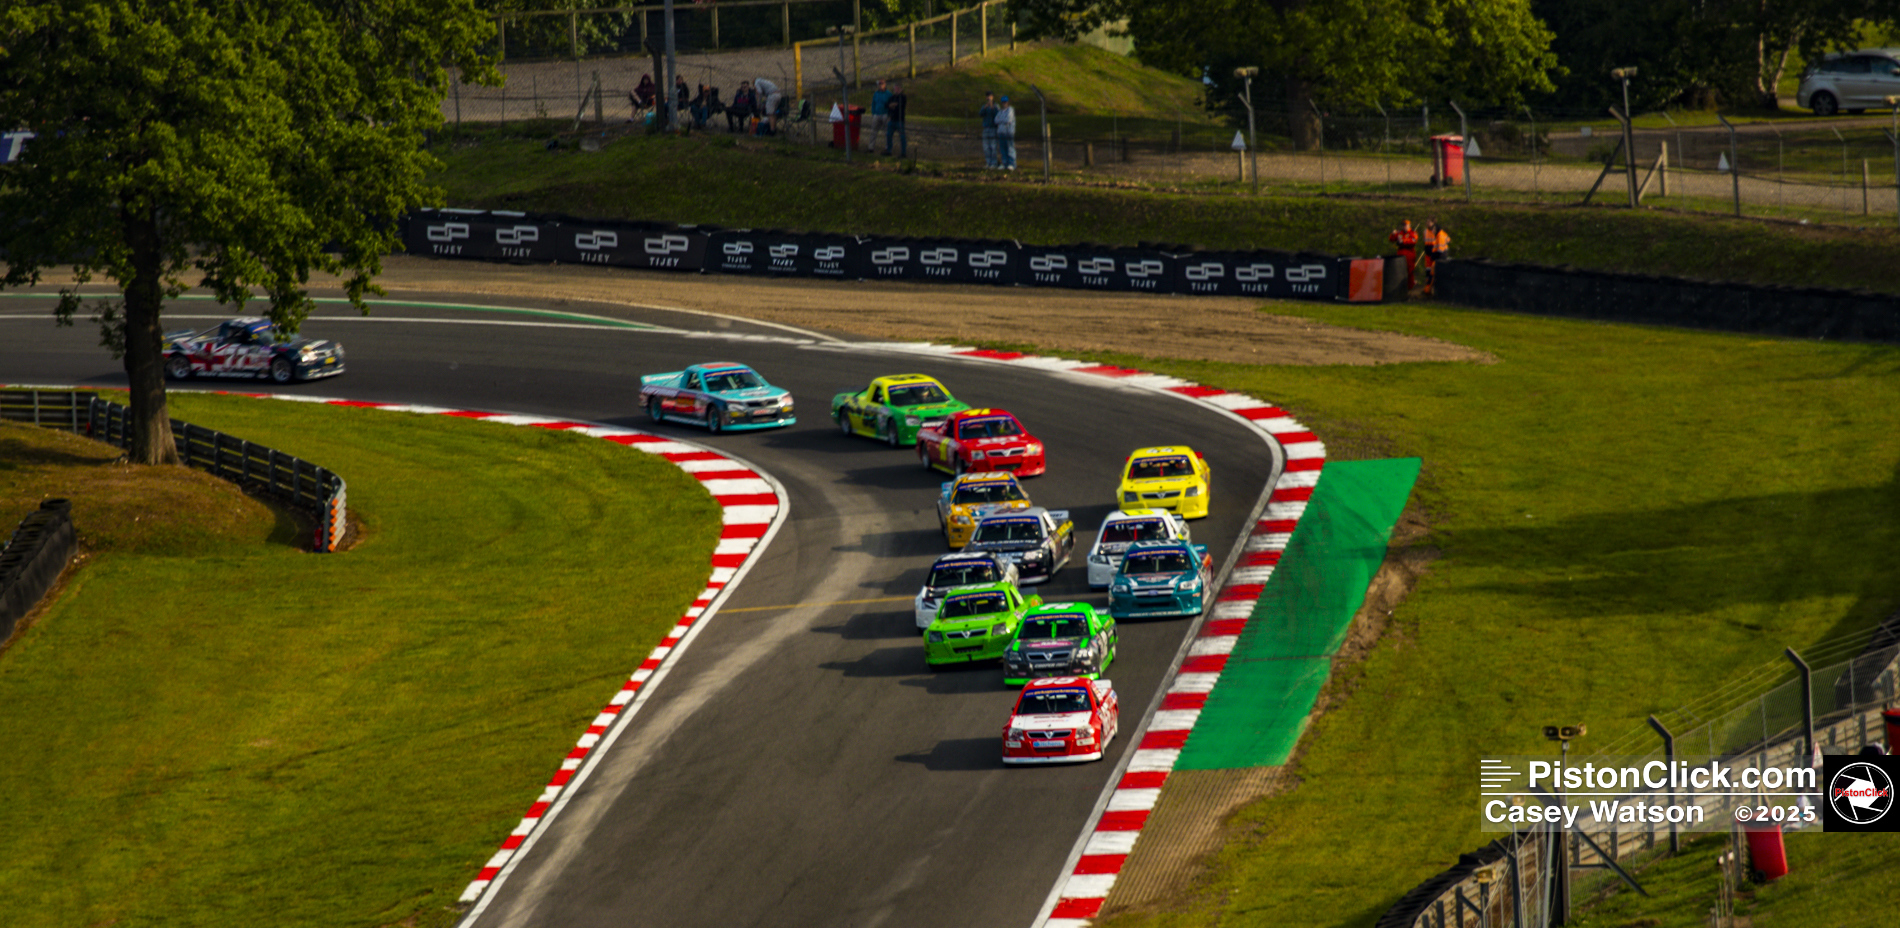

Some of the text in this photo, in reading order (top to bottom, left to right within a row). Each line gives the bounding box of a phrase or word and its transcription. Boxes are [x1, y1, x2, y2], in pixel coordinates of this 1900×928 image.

[433, 244, 463, 255] TIJEY
[502, 247, 531, 258] TIJEY
[580, 252, 610, 263] TIJEY
[650, 256, 679, 267] TIJEY
[878, 266, 904, 275] TIJEY
[925, 267, 951, 276] TIJEY
[974, 269, 1000, 278] TIJEY
[1035, 273, 1060, 282] TIJEY
[1083, 276, 1108, 286] TIJEY
[1130, 279, 1156, 289] TIJEY
[1192, 282, 1218, 292] TIJEY
[1241, 284, 1268, 292] TIJEY
[1292, 284, 1319, 294] TIJEY
